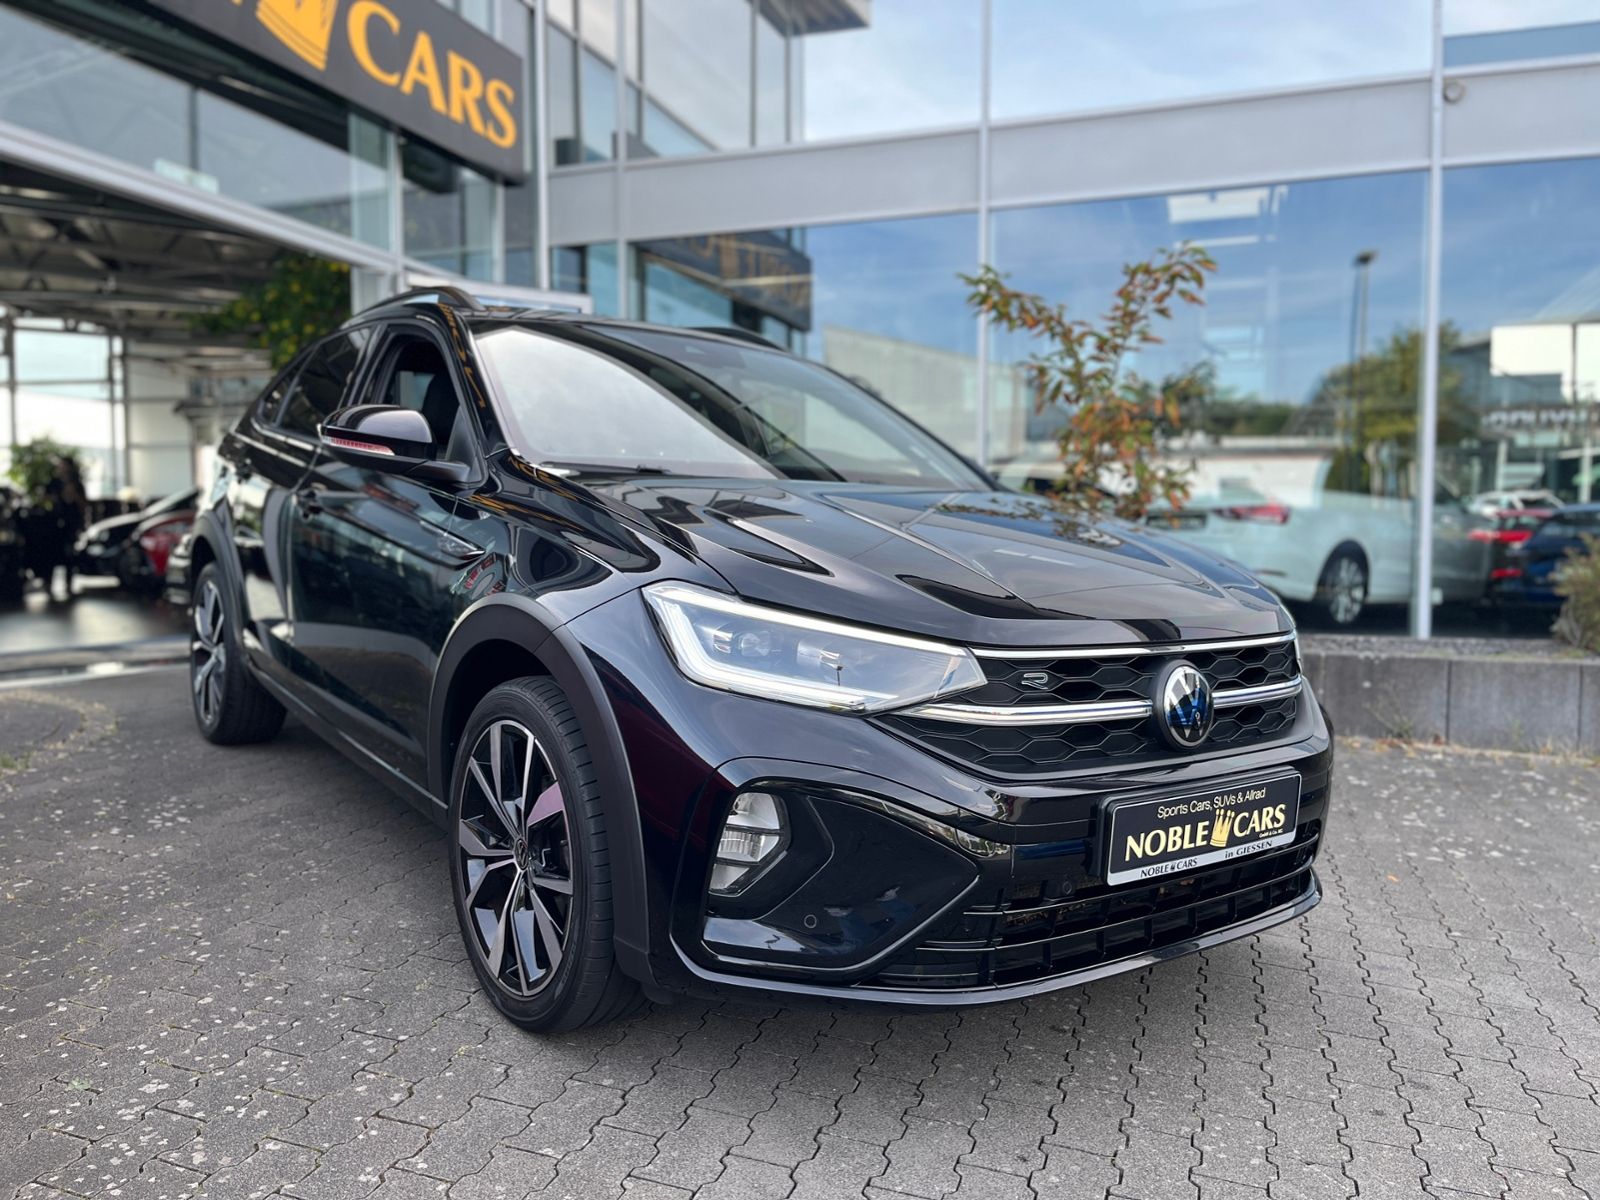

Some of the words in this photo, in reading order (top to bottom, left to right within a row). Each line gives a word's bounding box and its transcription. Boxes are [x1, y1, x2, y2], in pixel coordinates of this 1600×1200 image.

[346, 0, 518, 149] CARS
[1157, 804, 1188, 819] Sports
[1190, 800, 1213, 812] Cars,
[1213, 794, 1236, 809] SUVs
[1237, 792, 1244, 804] &
[1244, 788, 1265, 802] Allrad
[1125, 821, 1210, 861] NOBLE
[1234, 804, 1286, 837] CARS
[1224, 850, 1234, 859] in
[1236, 841, 1272, 856] GIESSEN
[1140, 864, 1170, 878] NOBLE
[1177, 858, 1198, 870] CARS
